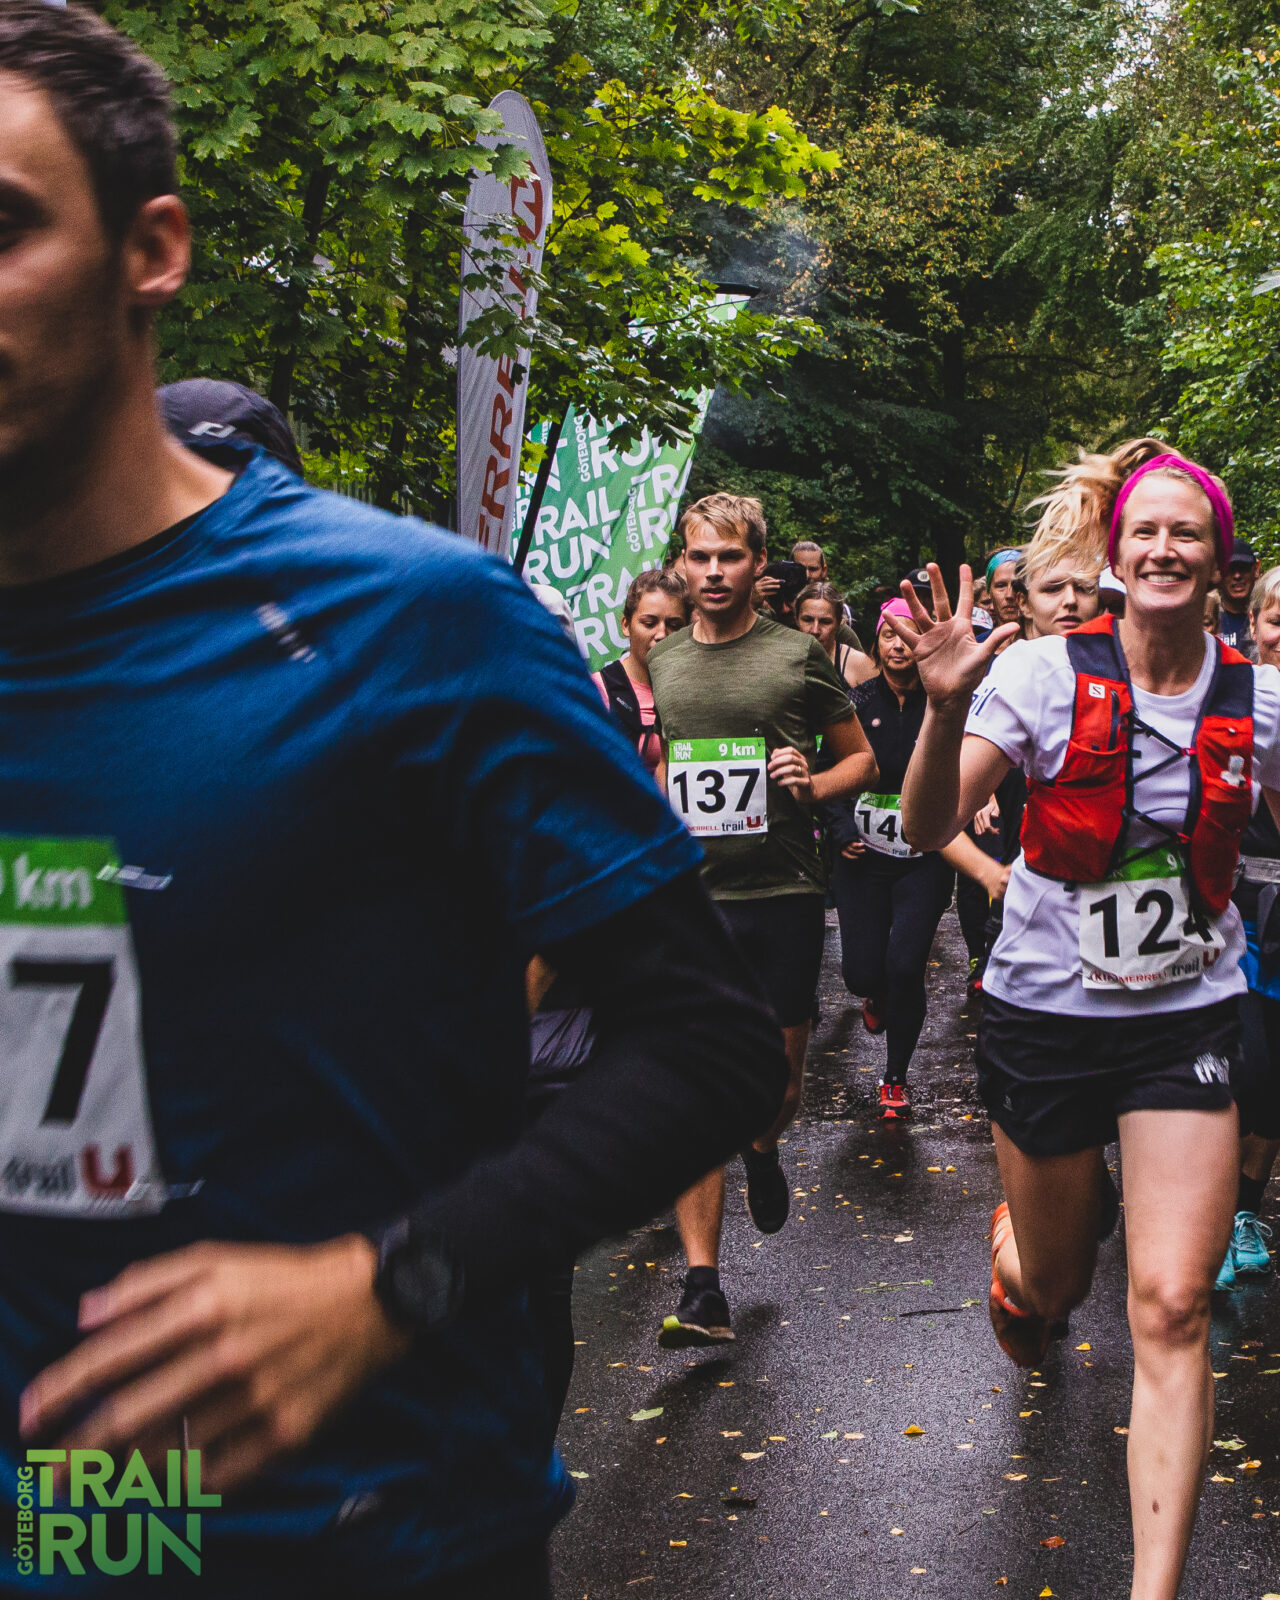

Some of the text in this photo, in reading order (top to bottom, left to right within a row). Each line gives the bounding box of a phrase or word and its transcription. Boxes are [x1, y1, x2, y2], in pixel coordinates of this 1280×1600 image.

[573, 414, 591, 483] GÖTEBORG
[533, 486, 621, 547] RAIL
[522, 524, 612, 586] RUN
[673, 742, 756, 757] TRAIL 9 km
[675, 751, 692, 761] RUN
[673, 768, 761, 814] 137
[721, 820, 744, 832] trail
[856, 810, 911, 845] 14
[13, 853, 94, 910] km
[1166, 853, 1178, 871] 9
